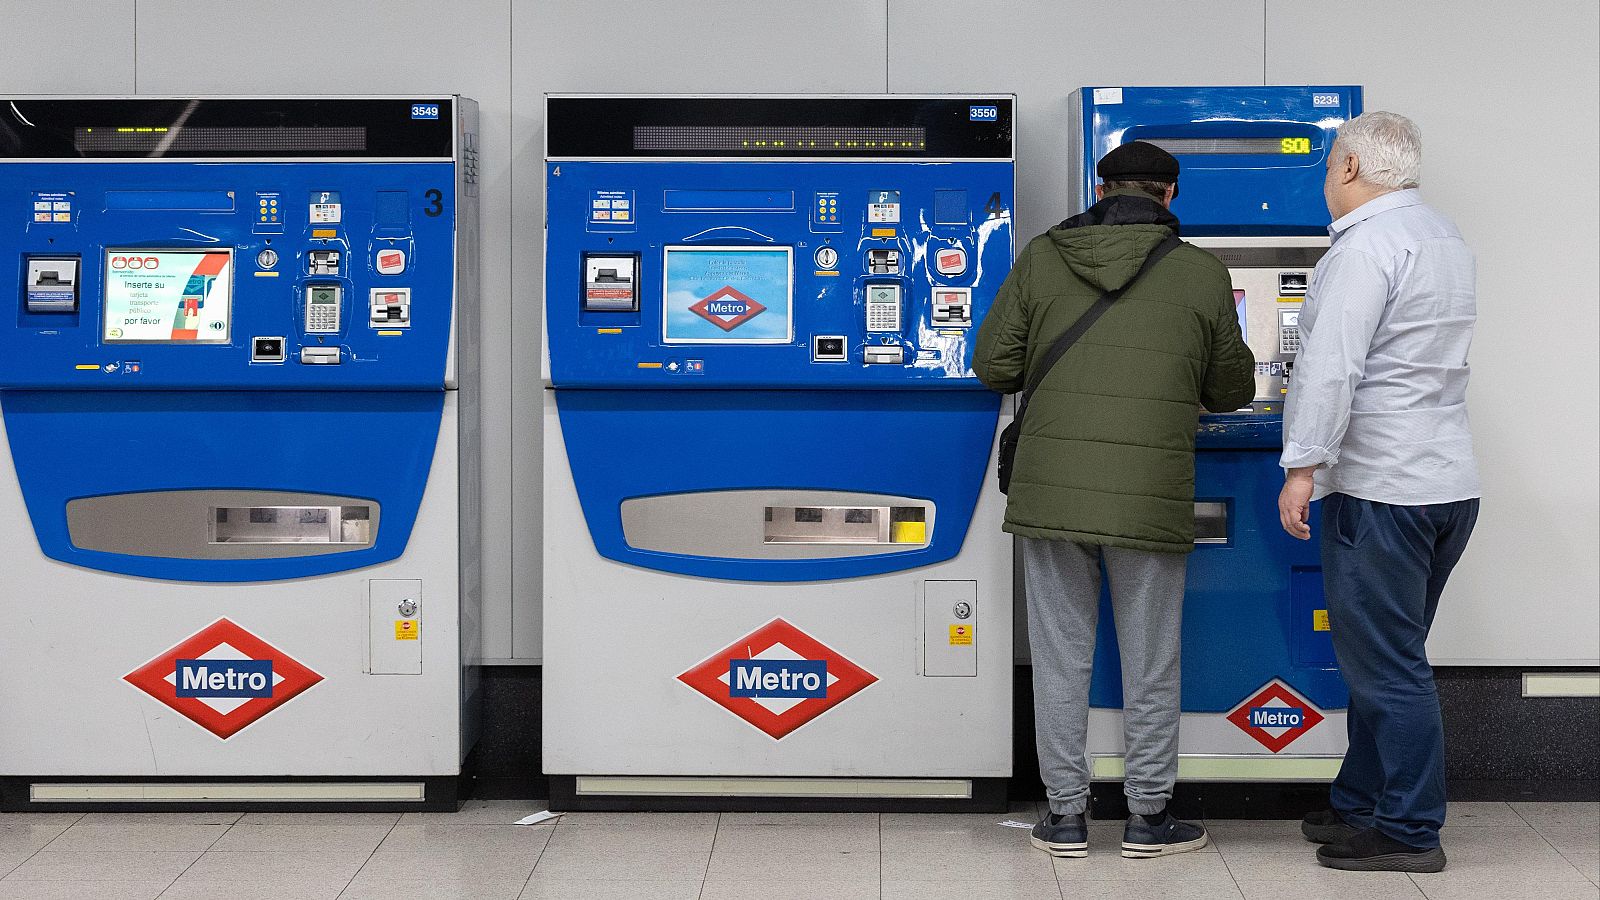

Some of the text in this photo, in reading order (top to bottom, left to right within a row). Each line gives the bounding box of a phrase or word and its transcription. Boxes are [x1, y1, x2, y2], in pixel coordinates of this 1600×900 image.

[1313, 96, 1339, 105] 6234
[412, 106, 438, 116] 3549
[971, 108, 997, 118] 3550
[553, 166, 562, 177] 4
[424, 189, 443, 217] 3
[985, 192, 1004, 219] 4
[125, 281, 153, 289] Inserte
[711, 303, 743, 313] Metro
[125, 317, 161, 326] por favor
[183, 666, 266, 690] Metro
[737, 666, 820, 690] Metro
[1254, 711, 1299, 725] Metro
